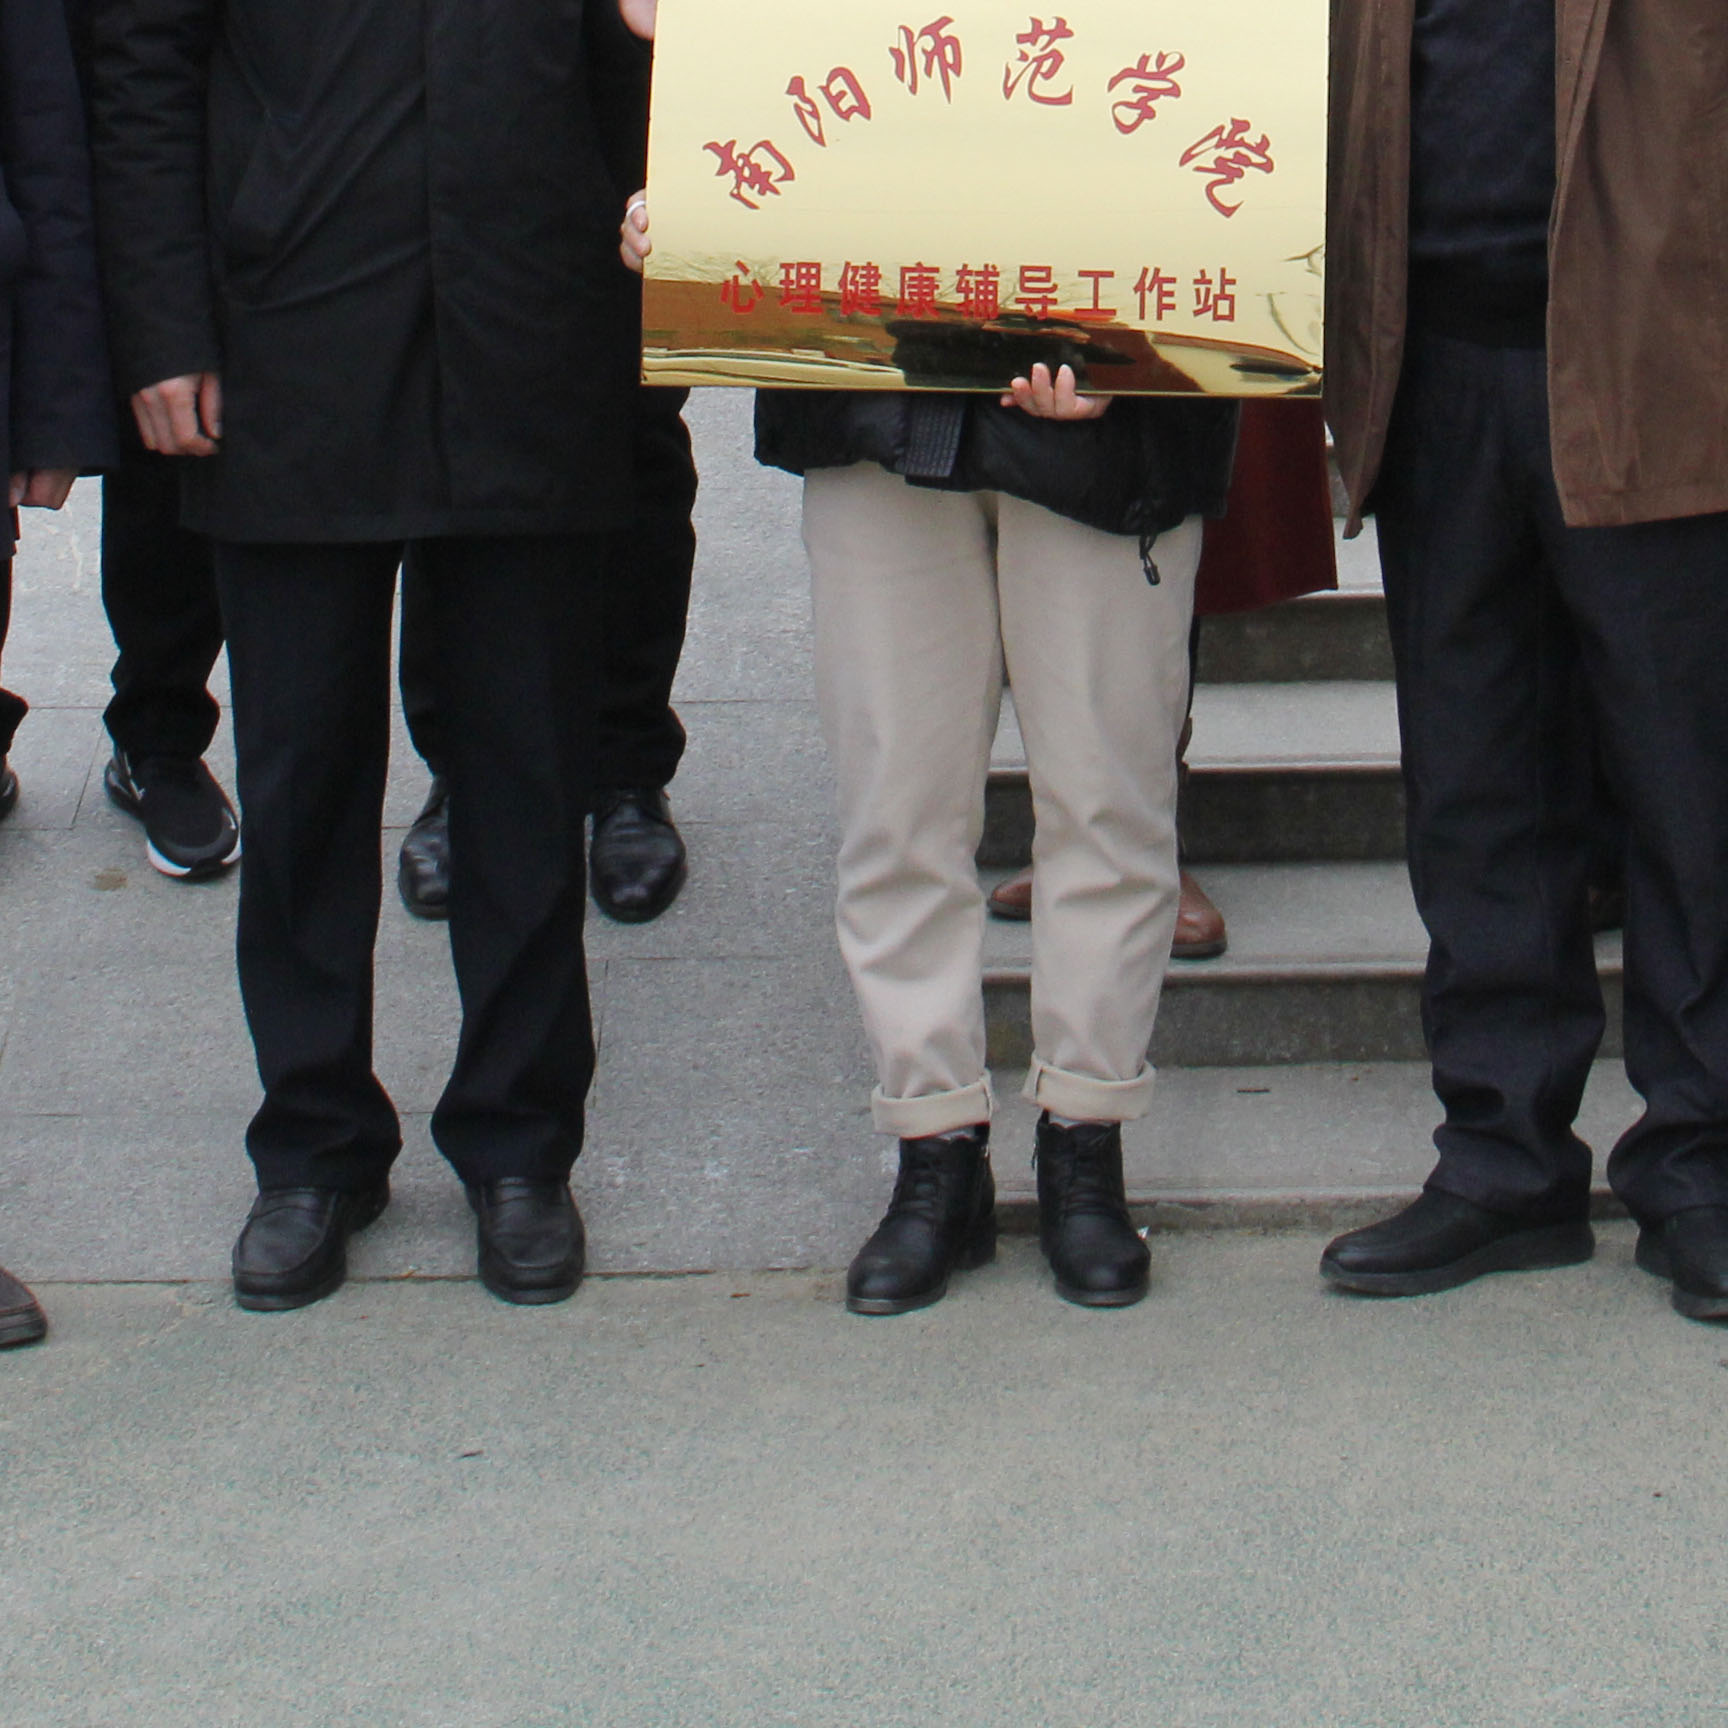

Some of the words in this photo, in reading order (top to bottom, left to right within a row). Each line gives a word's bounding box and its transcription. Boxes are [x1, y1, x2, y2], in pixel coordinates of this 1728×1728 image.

[702, 15, 1275, 219] 南阳师范学院
[719, 259, 1238, 324] 心理健康辅导工作站
